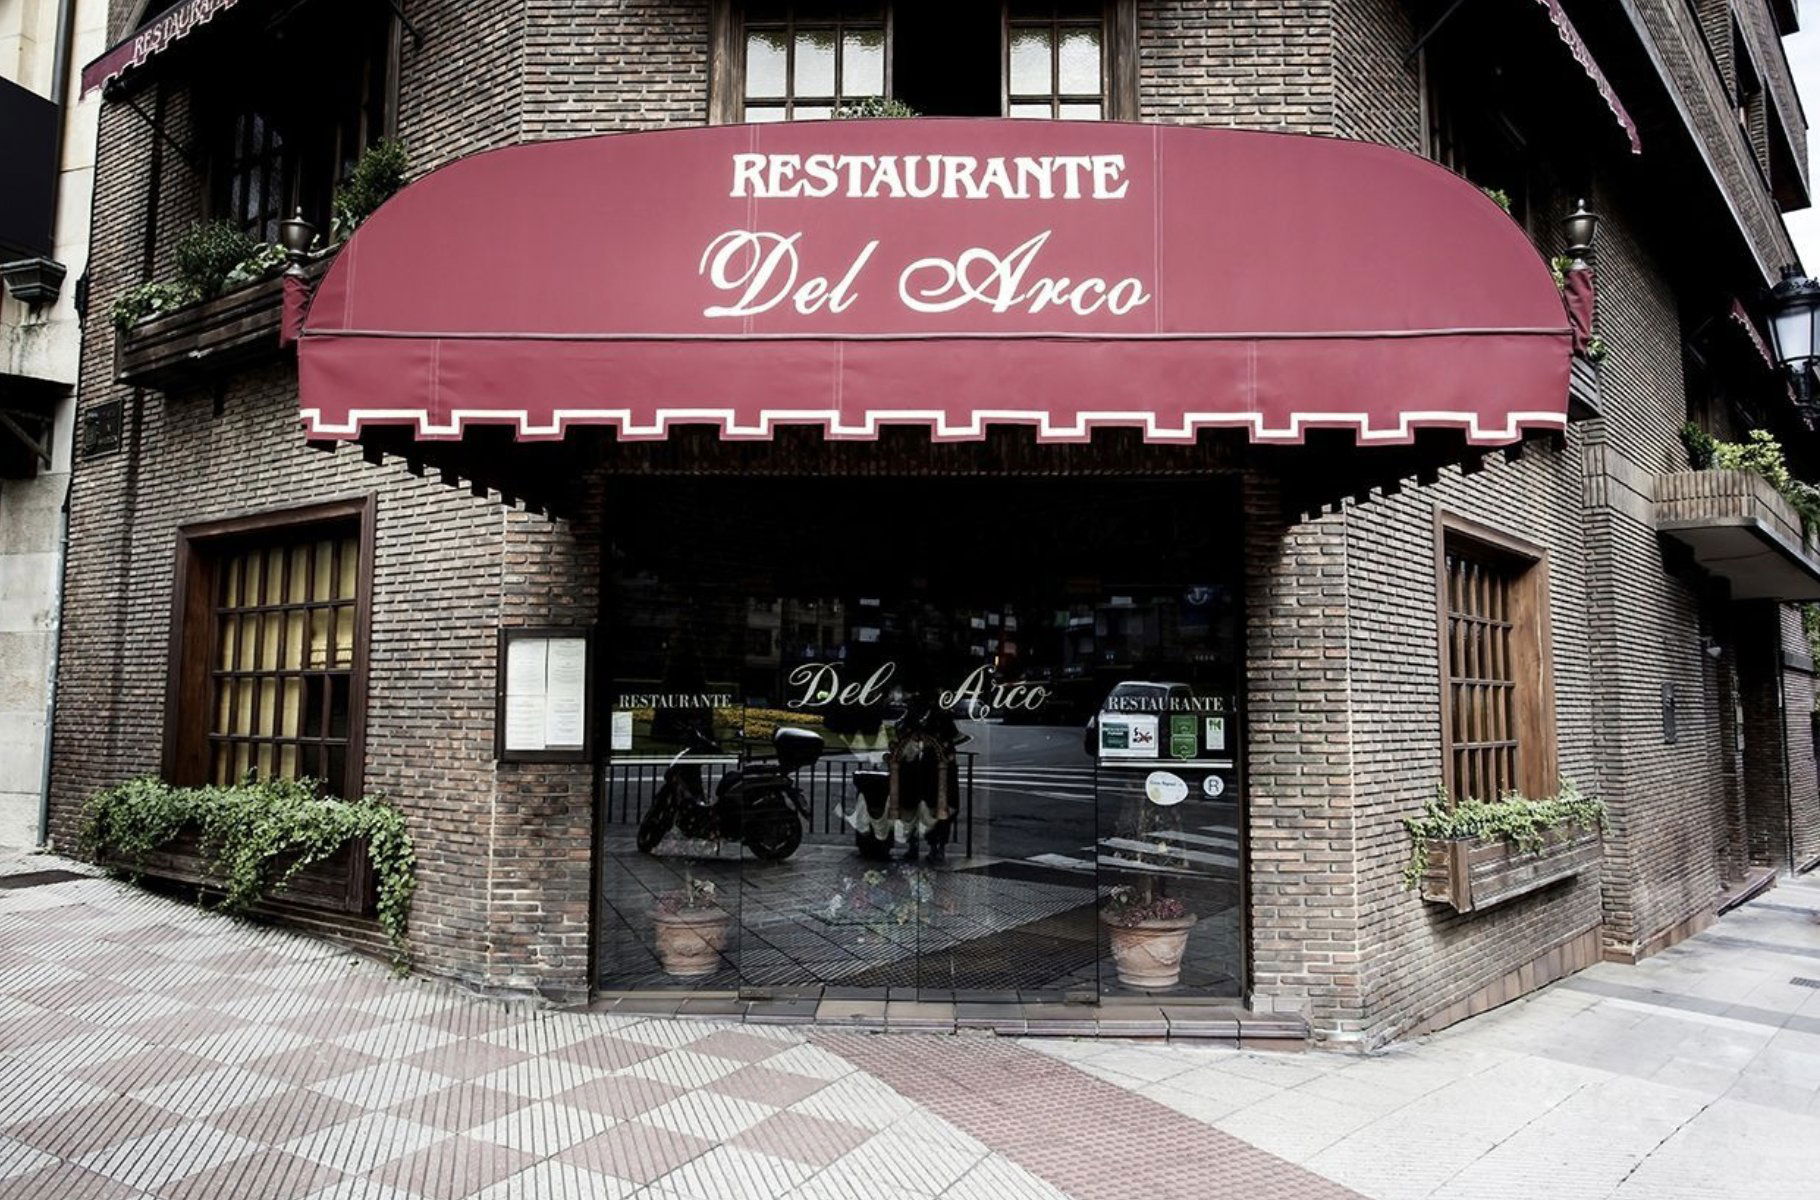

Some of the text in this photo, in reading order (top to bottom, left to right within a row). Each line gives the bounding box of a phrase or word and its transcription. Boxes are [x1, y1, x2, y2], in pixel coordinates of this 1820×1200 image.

[729, 153, 1129, 200] RESTAURANTE
[699, 229, 1150, 318] Del Arco
[619, 694, 732, 708] RESTAURANTE
[787, 661, 1053, 722] Del Arco
[1108, 696, 1224, 711] RESTAURANTE
